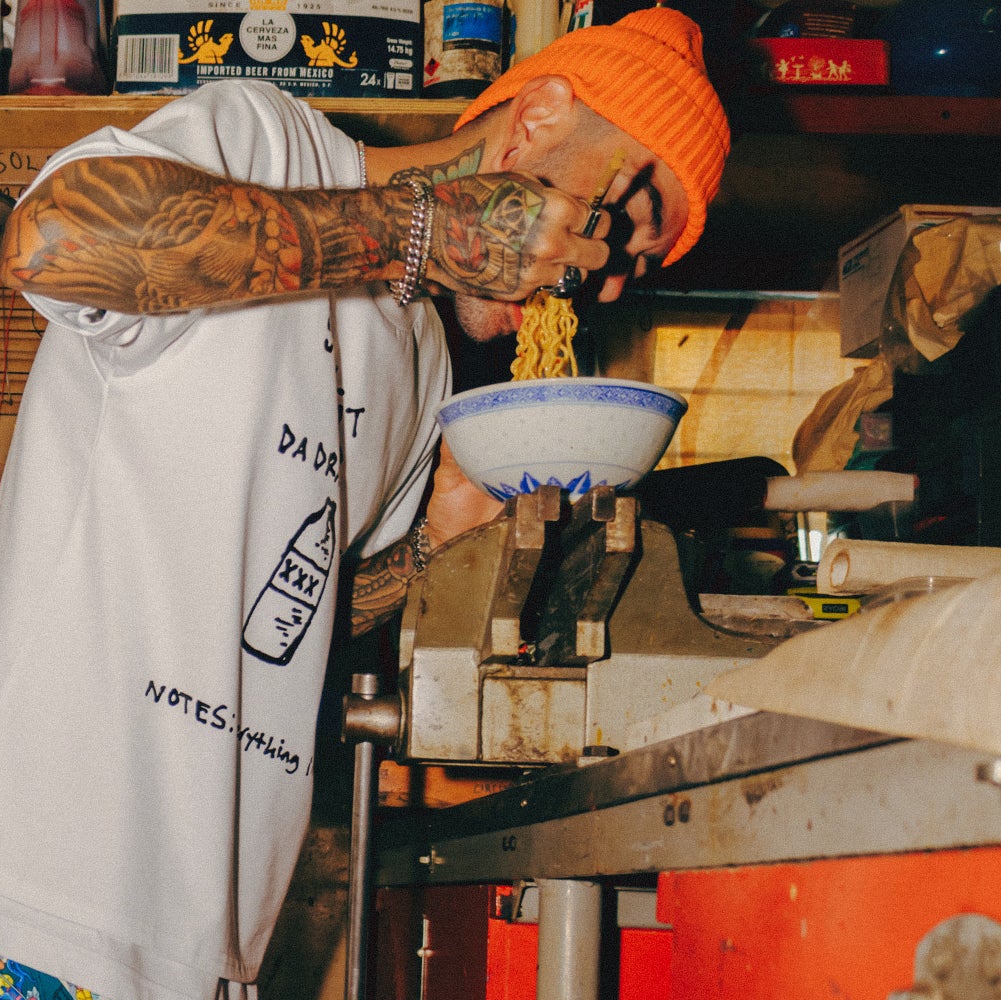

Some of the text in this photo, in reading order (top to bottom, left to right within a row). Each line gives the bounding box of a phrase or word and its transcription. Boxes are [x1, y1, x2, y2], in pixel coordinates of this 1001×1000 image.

[197, 65, 334, 79] IMPORTED BEER FROM MEXICO
[145, 680, 236, 733] NOTES:
